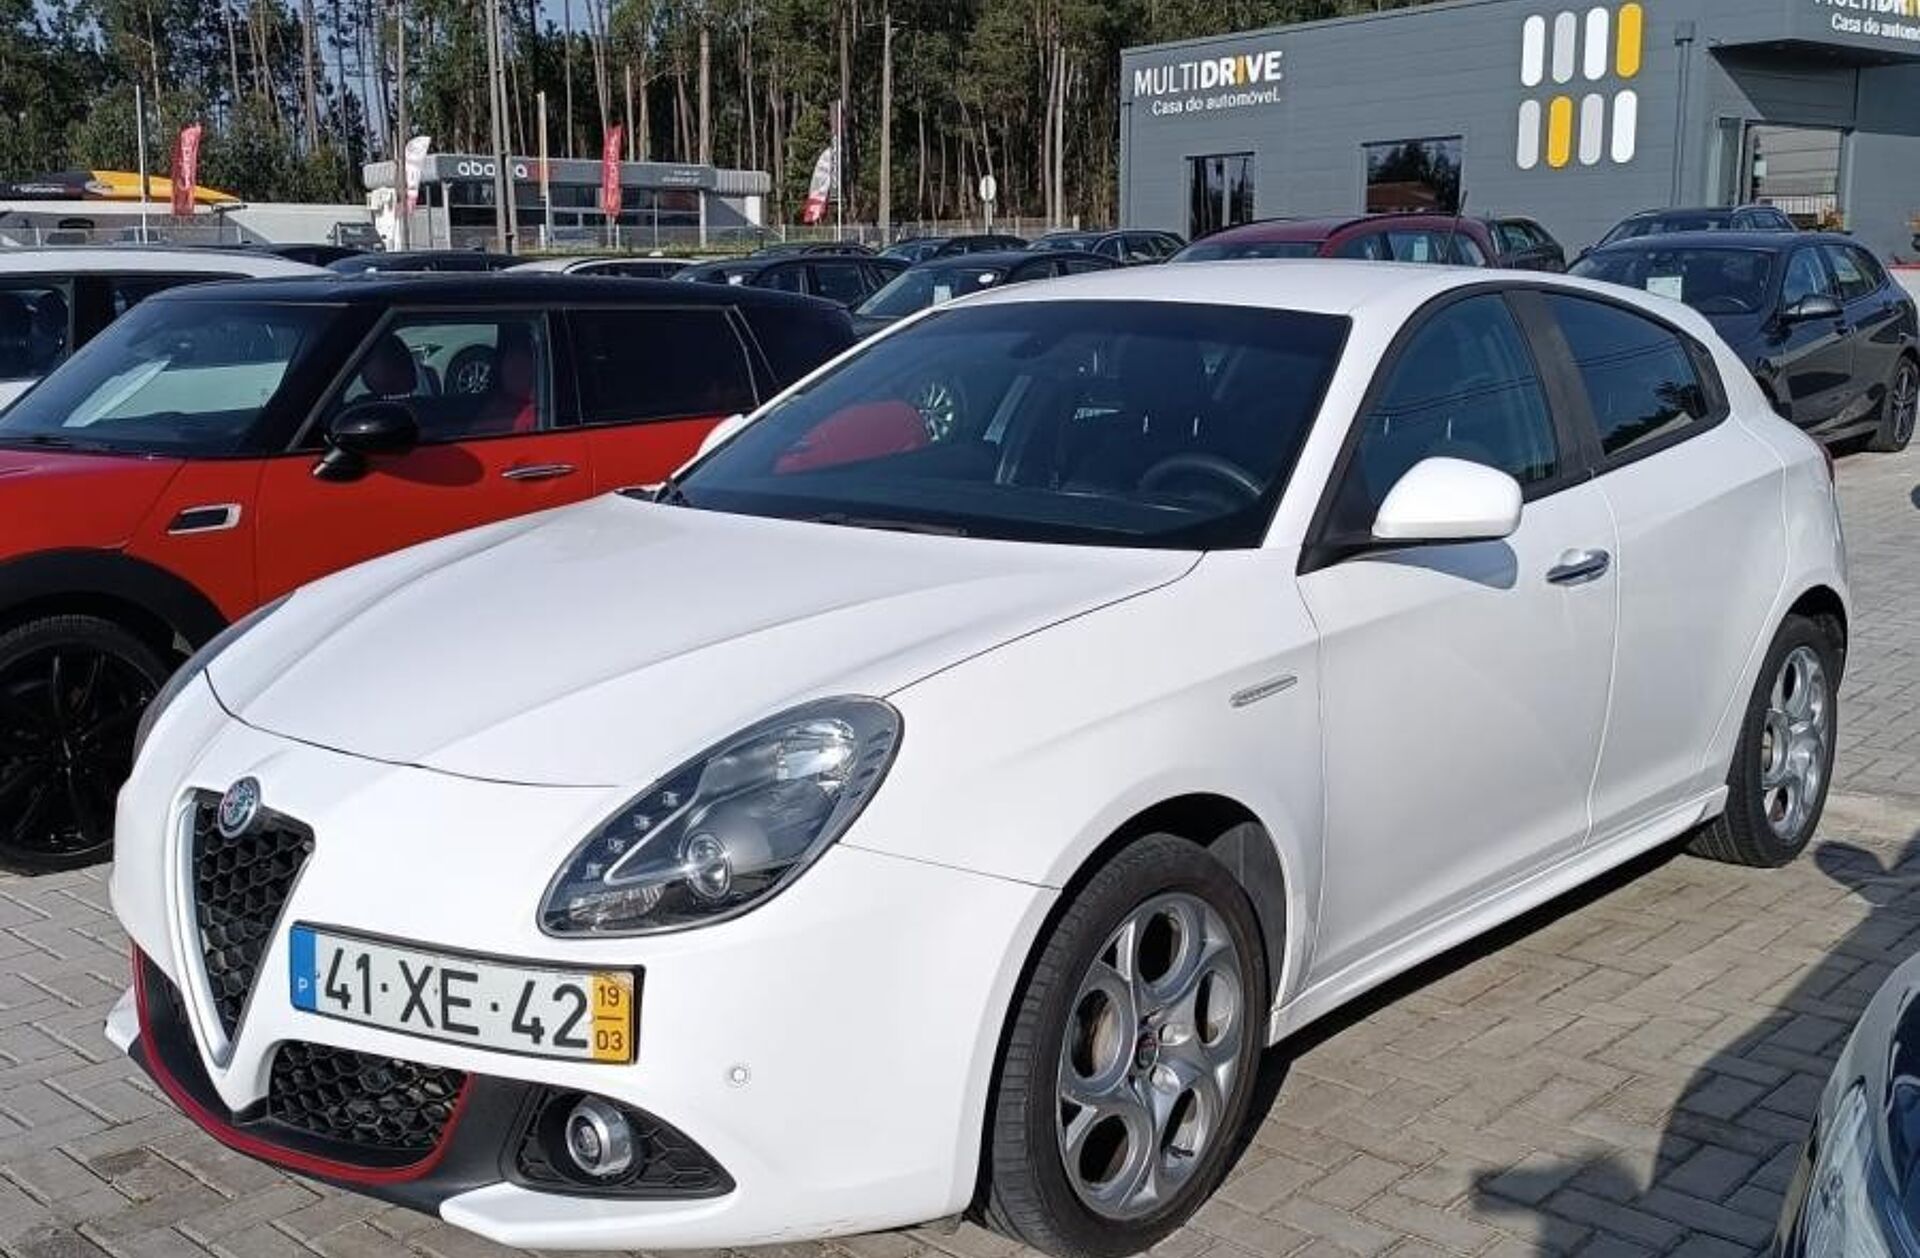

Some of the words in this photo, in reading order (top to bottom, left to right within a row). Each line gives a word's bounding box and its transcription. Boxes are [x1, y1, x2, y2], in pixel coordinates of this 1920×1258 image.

[1832, 13, 1861, 33] Casa
[1864, 17, 1880, 35] do
[1134, 51, 1283, 97] MULTIDRIVE
[1152, 100, 1183, 116] Casa
[1186, 95, 1203, 112] do
[299, 977, 308, 991] P
[598, 985, 620, 1007] 19
[597, 1029, 624, 1051] 03
